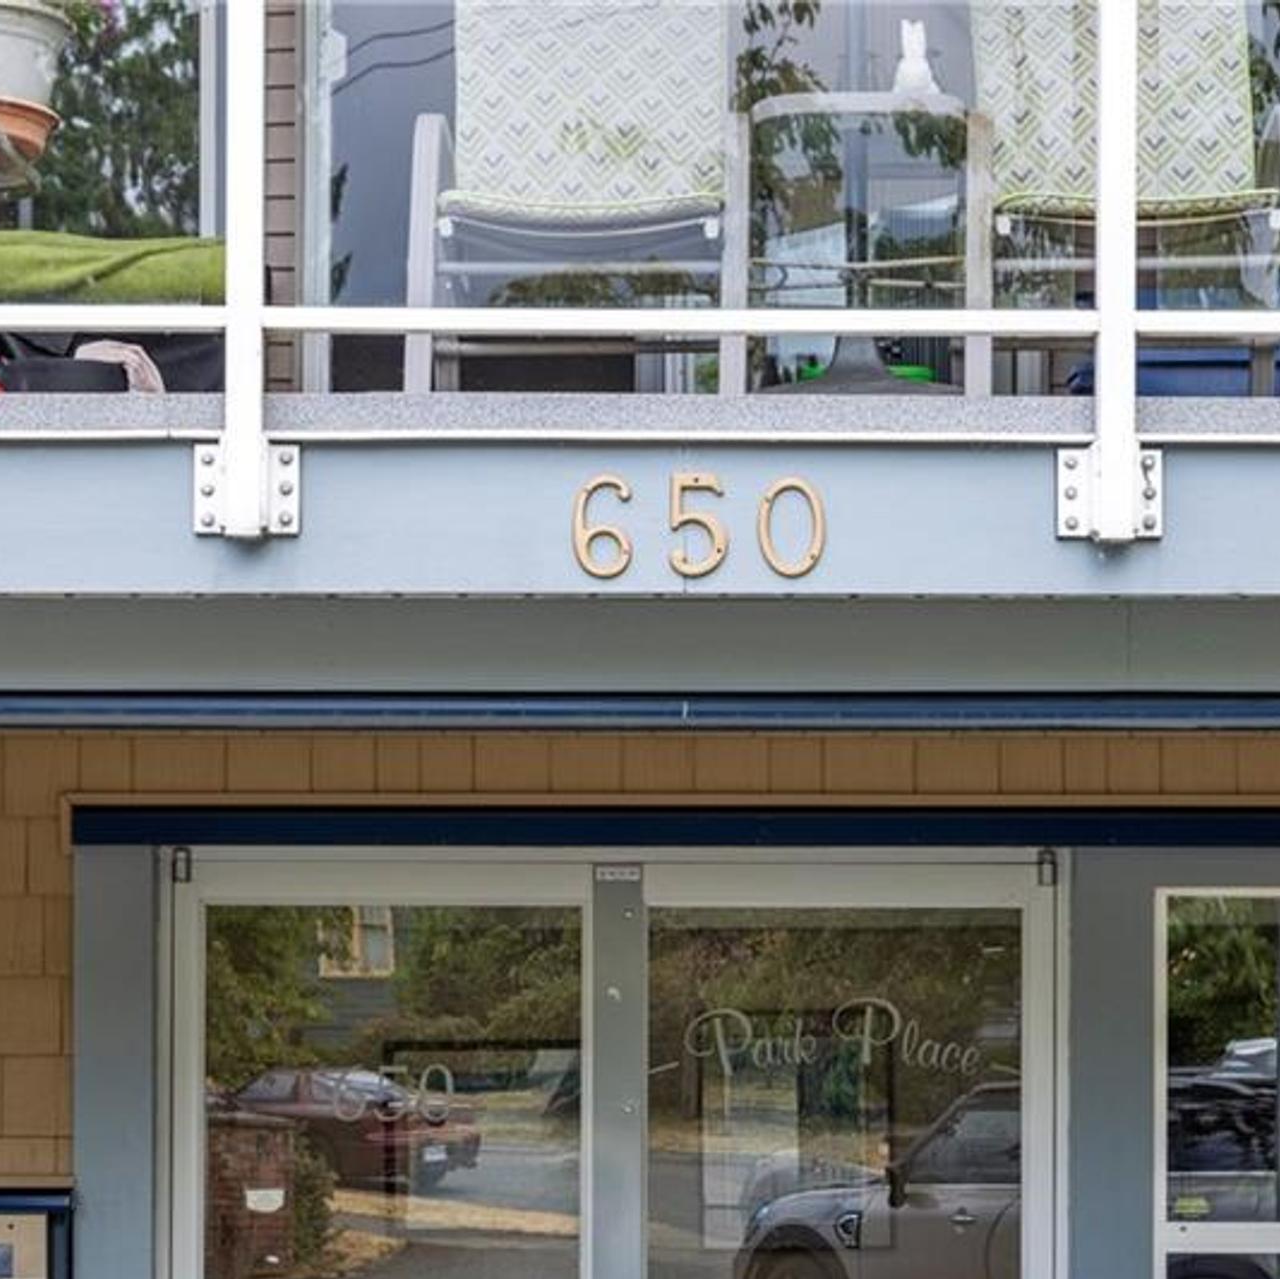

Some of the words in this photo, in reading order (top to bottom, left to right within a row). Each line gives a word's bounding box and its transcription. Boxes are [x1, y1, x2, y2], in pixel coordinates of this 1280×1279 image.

[572, 472, 826, 580] 650
[683, 1007, 818, 1077] Park
[832, 998, 982, 1075] Place
